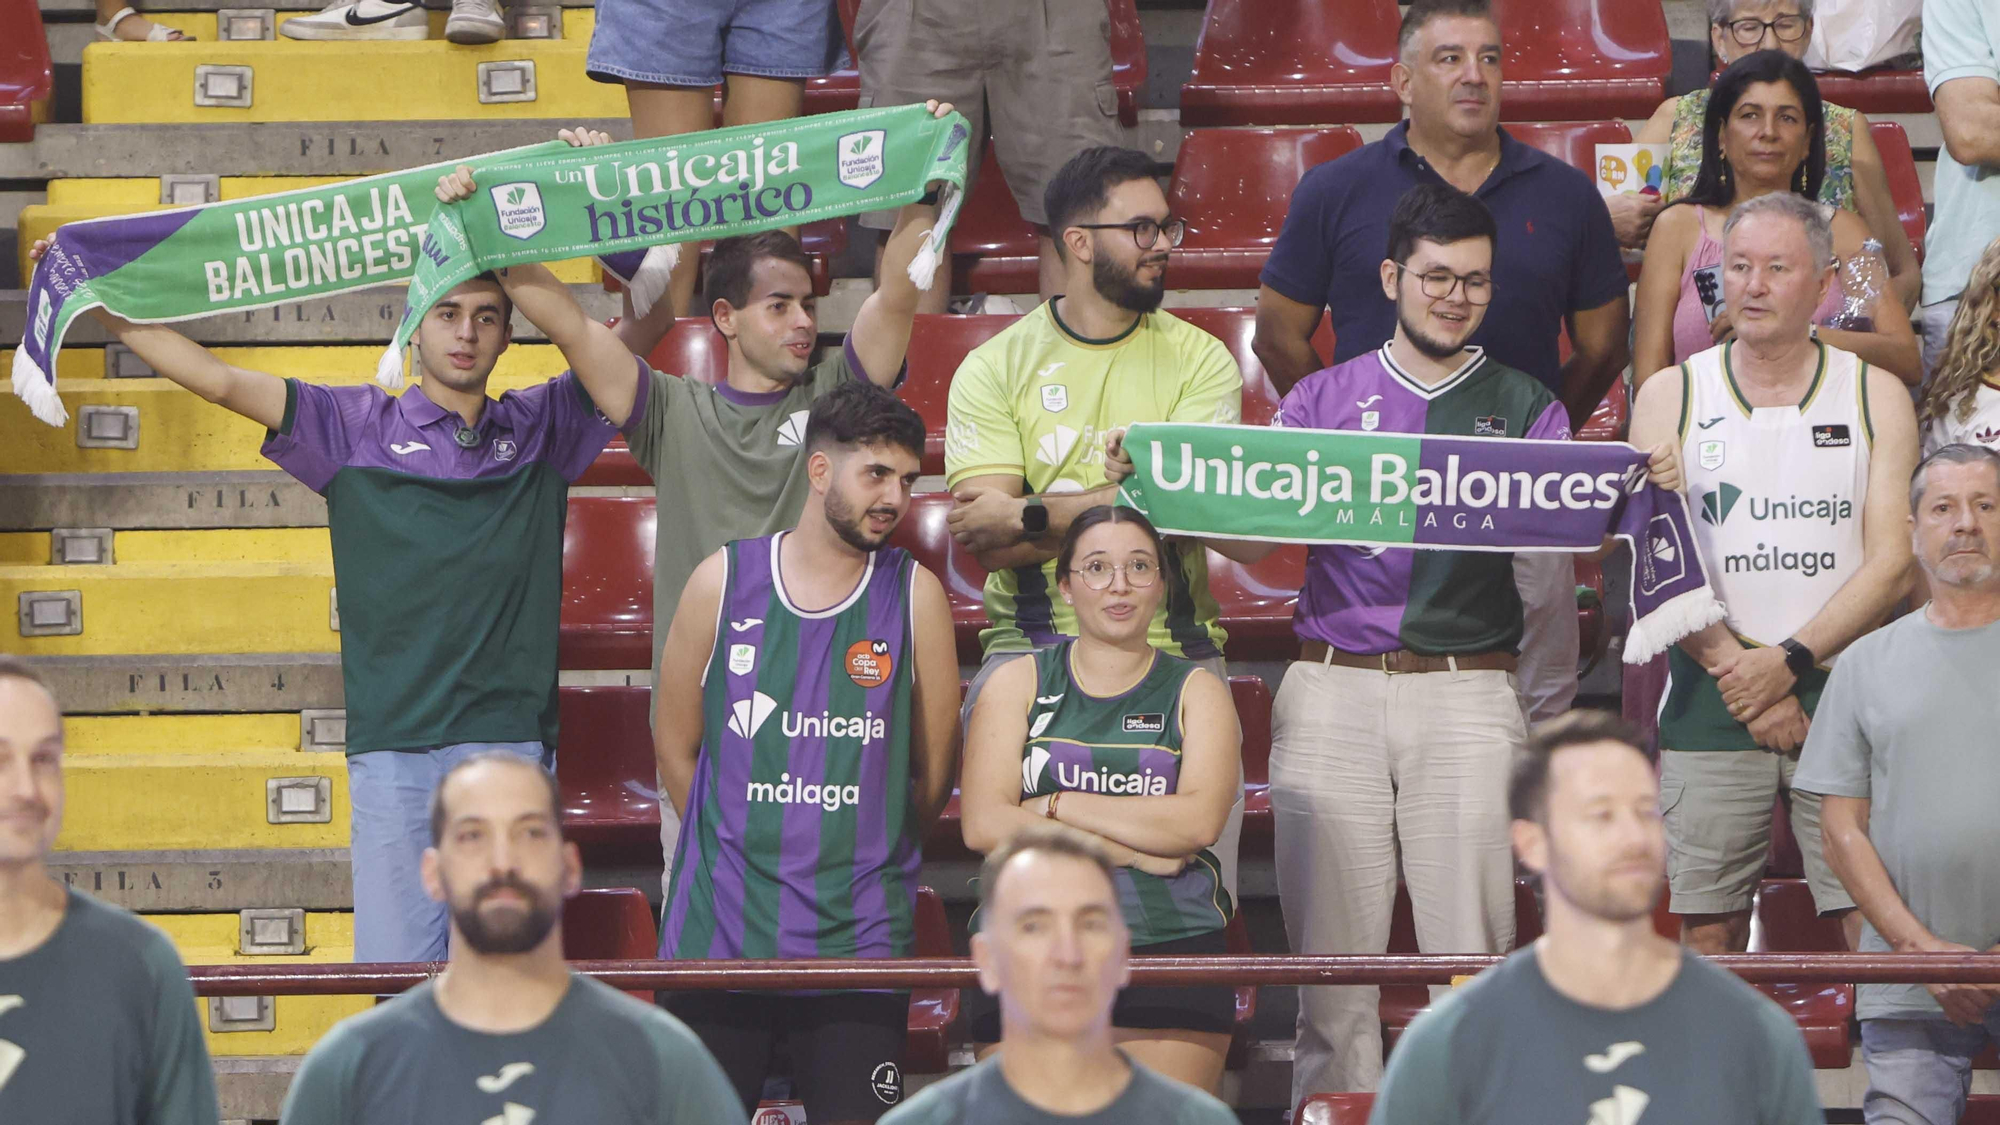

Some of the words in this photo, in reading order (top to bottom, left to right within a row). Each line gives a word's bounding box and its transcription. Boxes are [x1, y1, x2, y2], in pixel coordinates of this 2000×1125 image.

[300, 138, 390, 156] FILA
[433, 138, 445, 155] 7
[554, 169, 584, 184] Un
[580, 136, 802, 201] Unicaja
[234, 183, 414, 252] UNICAJA
[585, 181, 813, 243] histórico
[203, 223, 428, 301] BALONCEST
[244, 304, 336, 322] FILA
[379, 305, 393, 321] 6
[1150, 440, 1352, 513] Unicaja
[1370, 453, 1650, 510] Baloncest
[187, 487, 281, 509] FILA
[1750, 493, 1852, 526] Unicaja
[1335, 508, 1495, 531] MÁLAGA
[852, 658, 877, 666] Copa
[863, 667, 880, 675] Rey
[129, 673, 225, 692] FILA
[271, 673, 285, 690] 4
[781, 711, 885, 745] Unicaja
[1058, 762, 1168, 796] Unicaja
[64, 871, 162, 890] FILA
